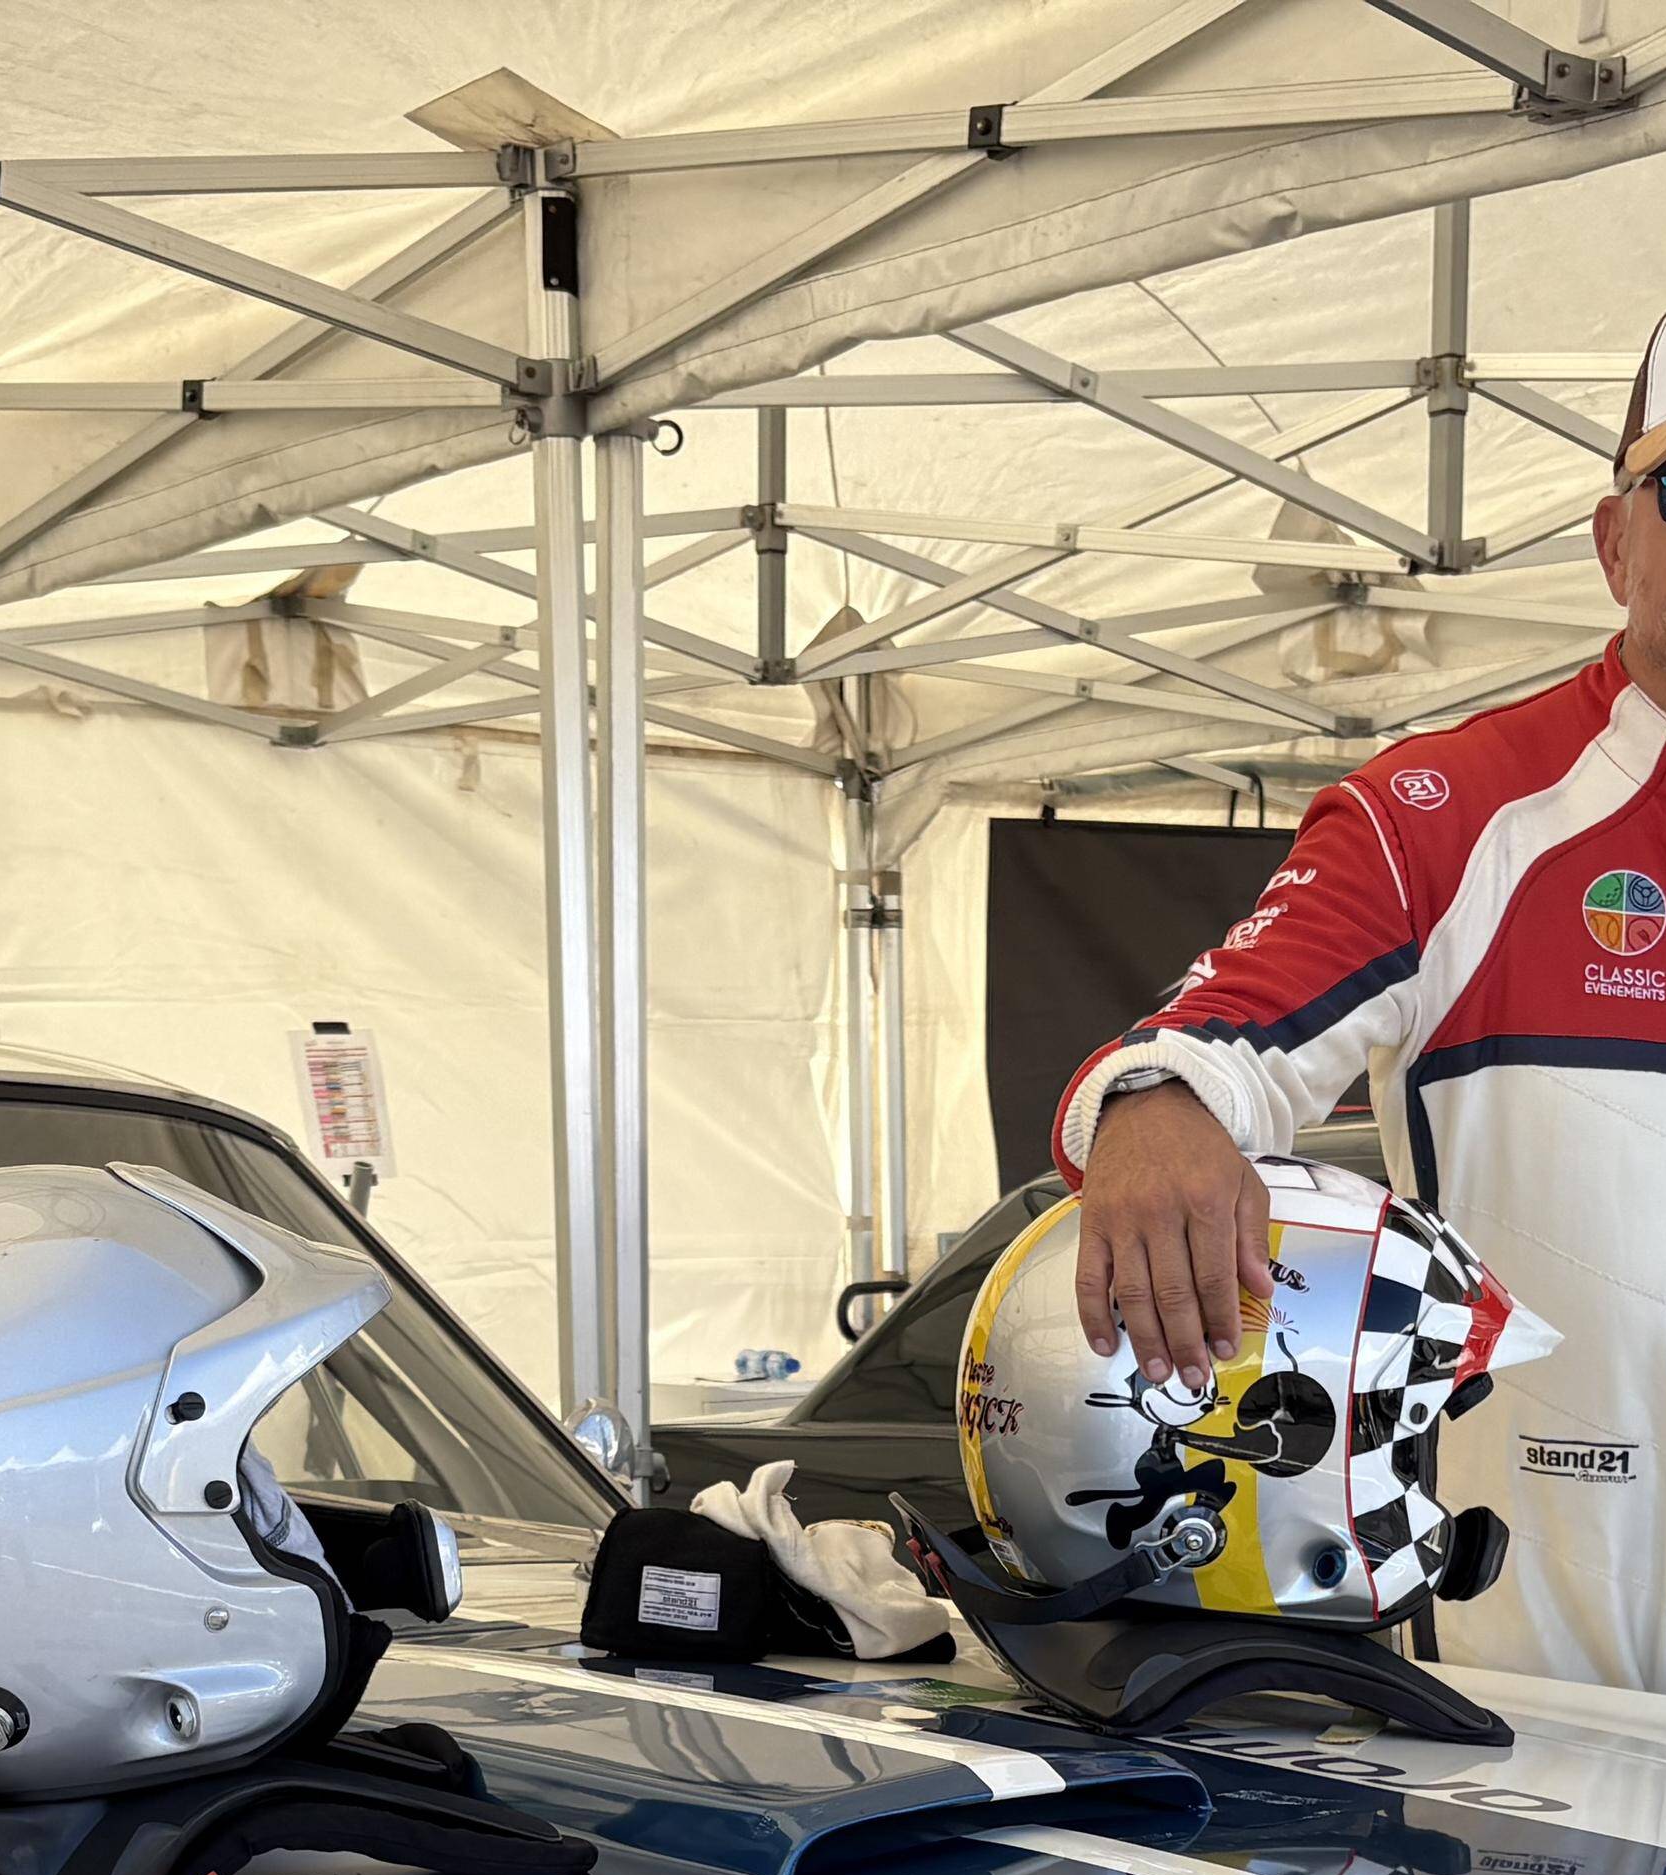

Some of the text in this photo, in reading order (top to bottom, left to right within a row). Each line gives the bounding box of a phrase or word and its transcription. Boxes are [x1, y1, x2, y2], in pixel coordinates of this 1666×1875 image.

[1403, 773, 1437, 796] 21
[1584, 963, 1666, 988] CLASSIC
[1584, 981, 1666, 1001] EVENEMENTS
[1527, 1446, 1629, 1474] stand21
